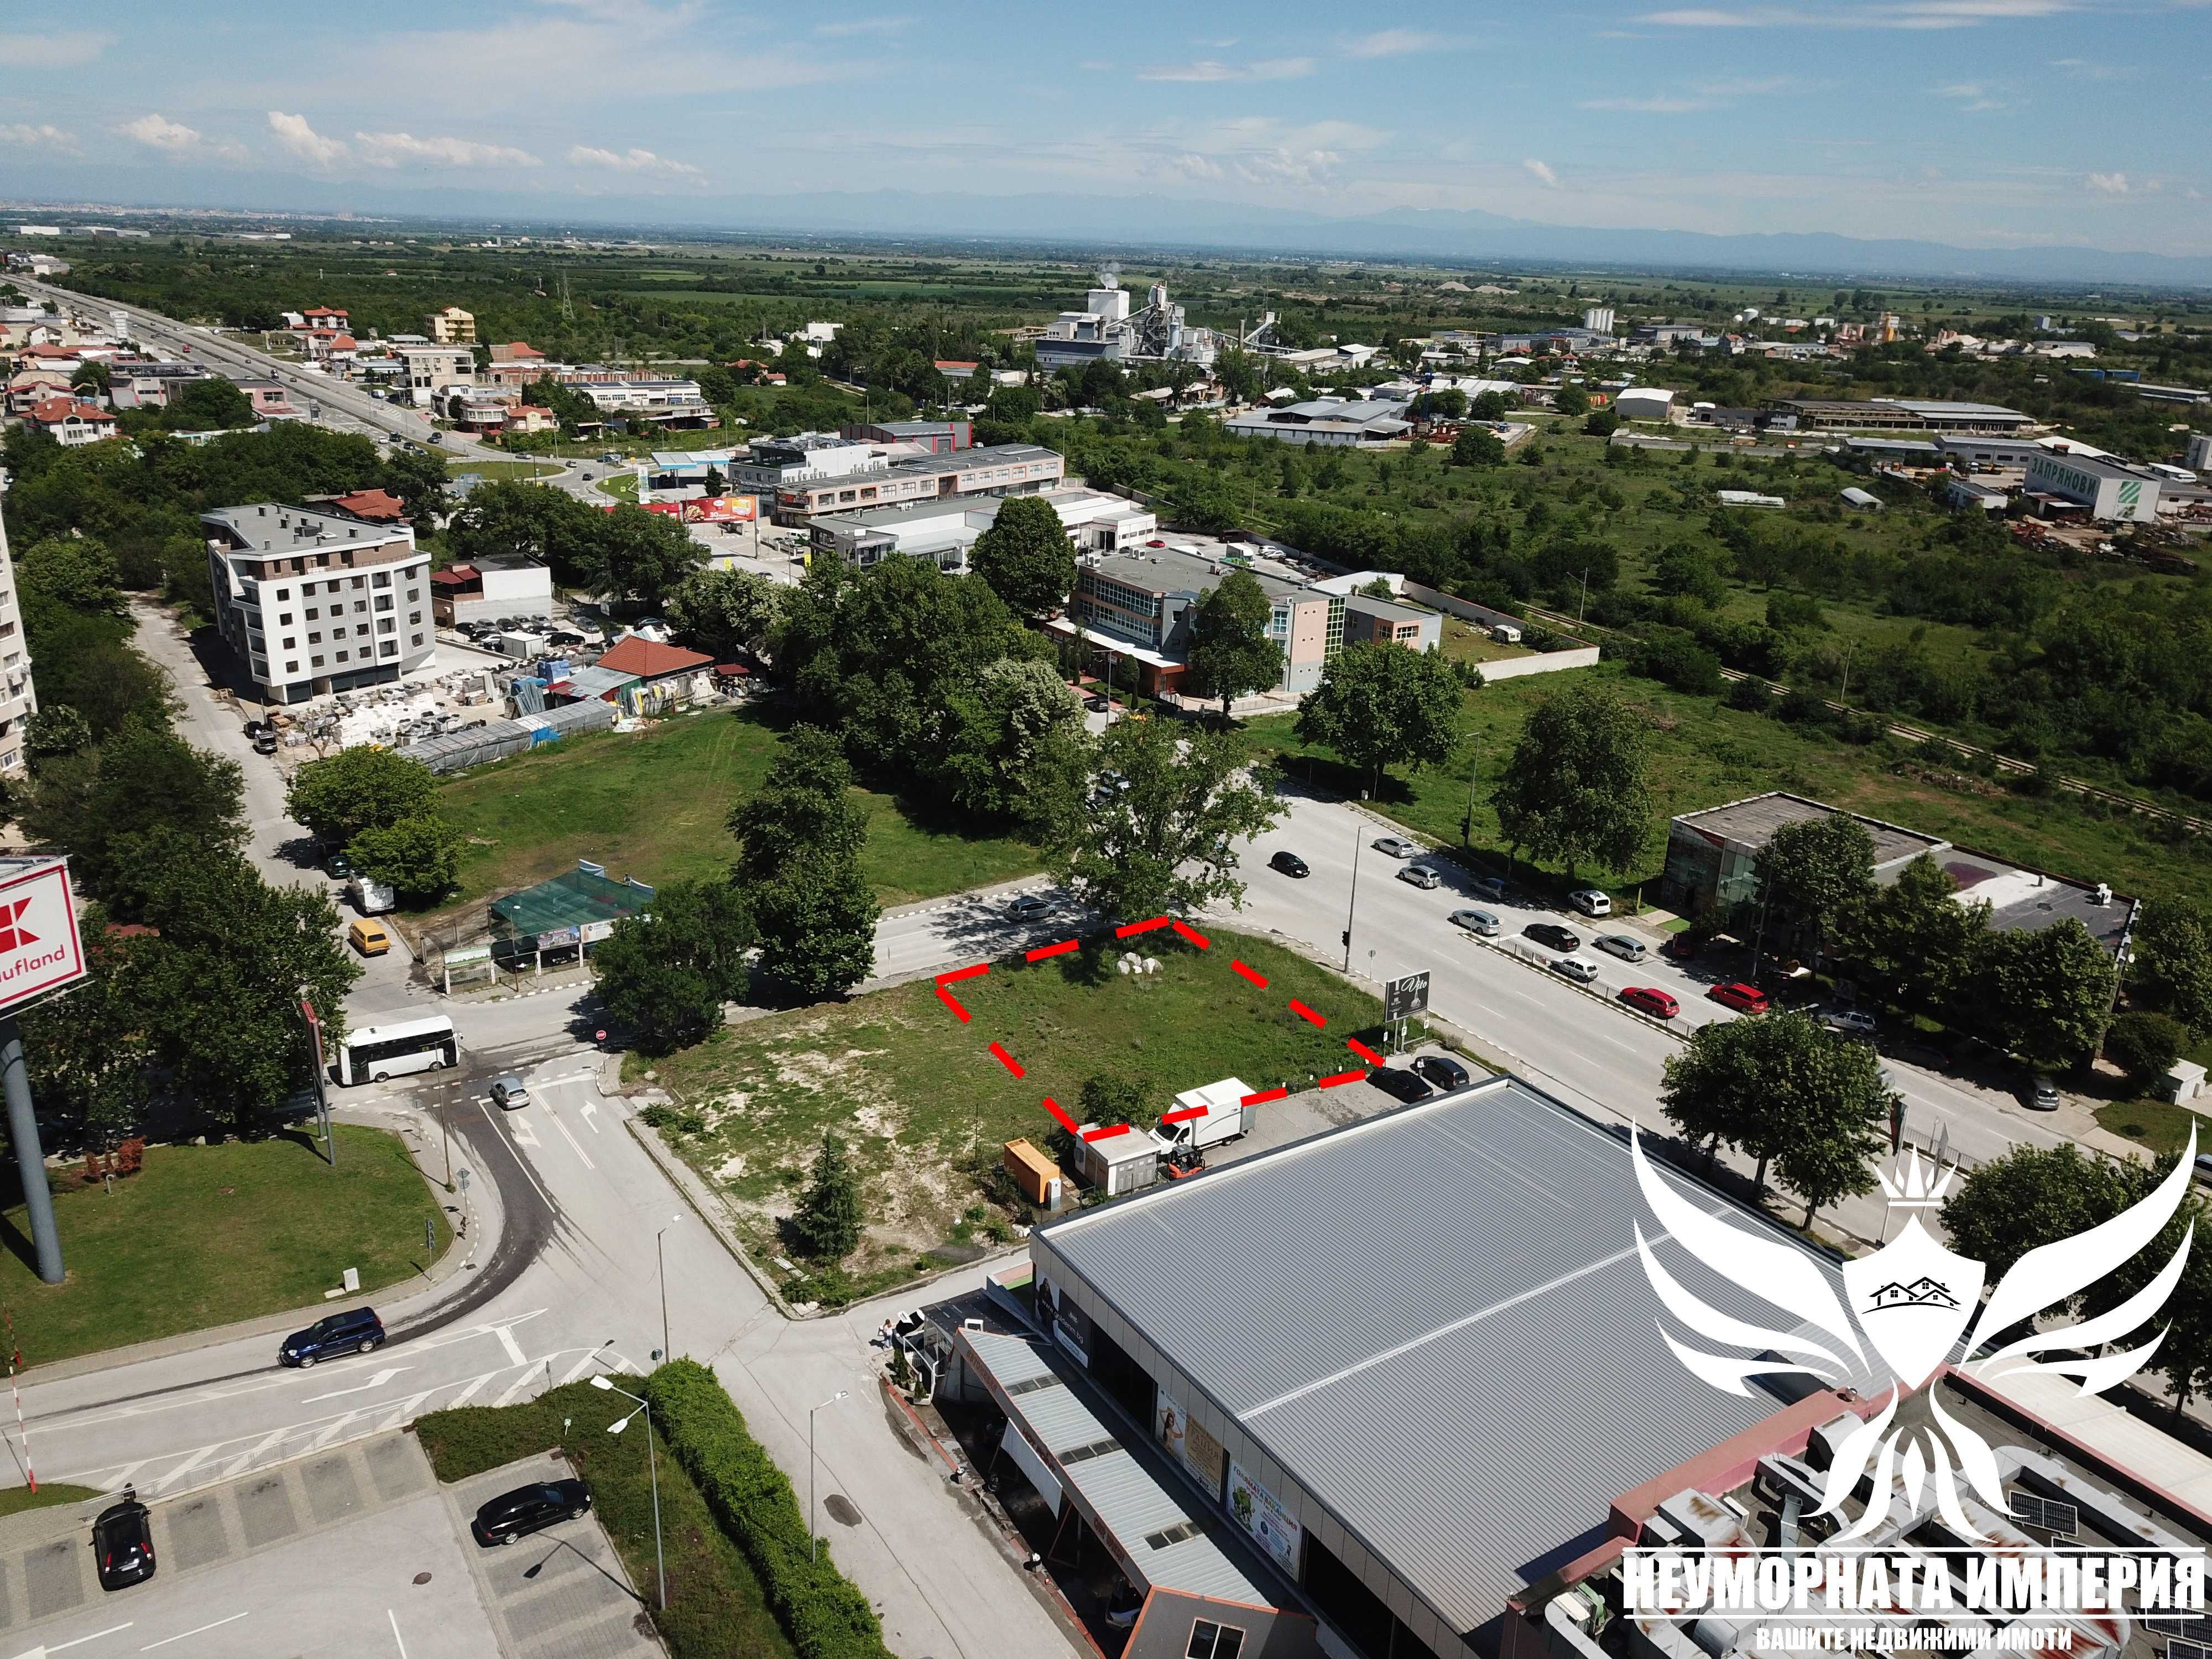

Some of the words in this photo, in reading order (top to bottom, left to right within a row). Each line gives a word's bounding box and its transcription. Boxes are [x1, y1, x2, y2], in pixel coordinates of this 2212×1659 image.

[2032, 457, 2097, 497] ЗАПРЯНОВИ
[1401, 975, 1427, 993] Vito
[1041, 1298, 1084, 1344] www.goldenm.bg
